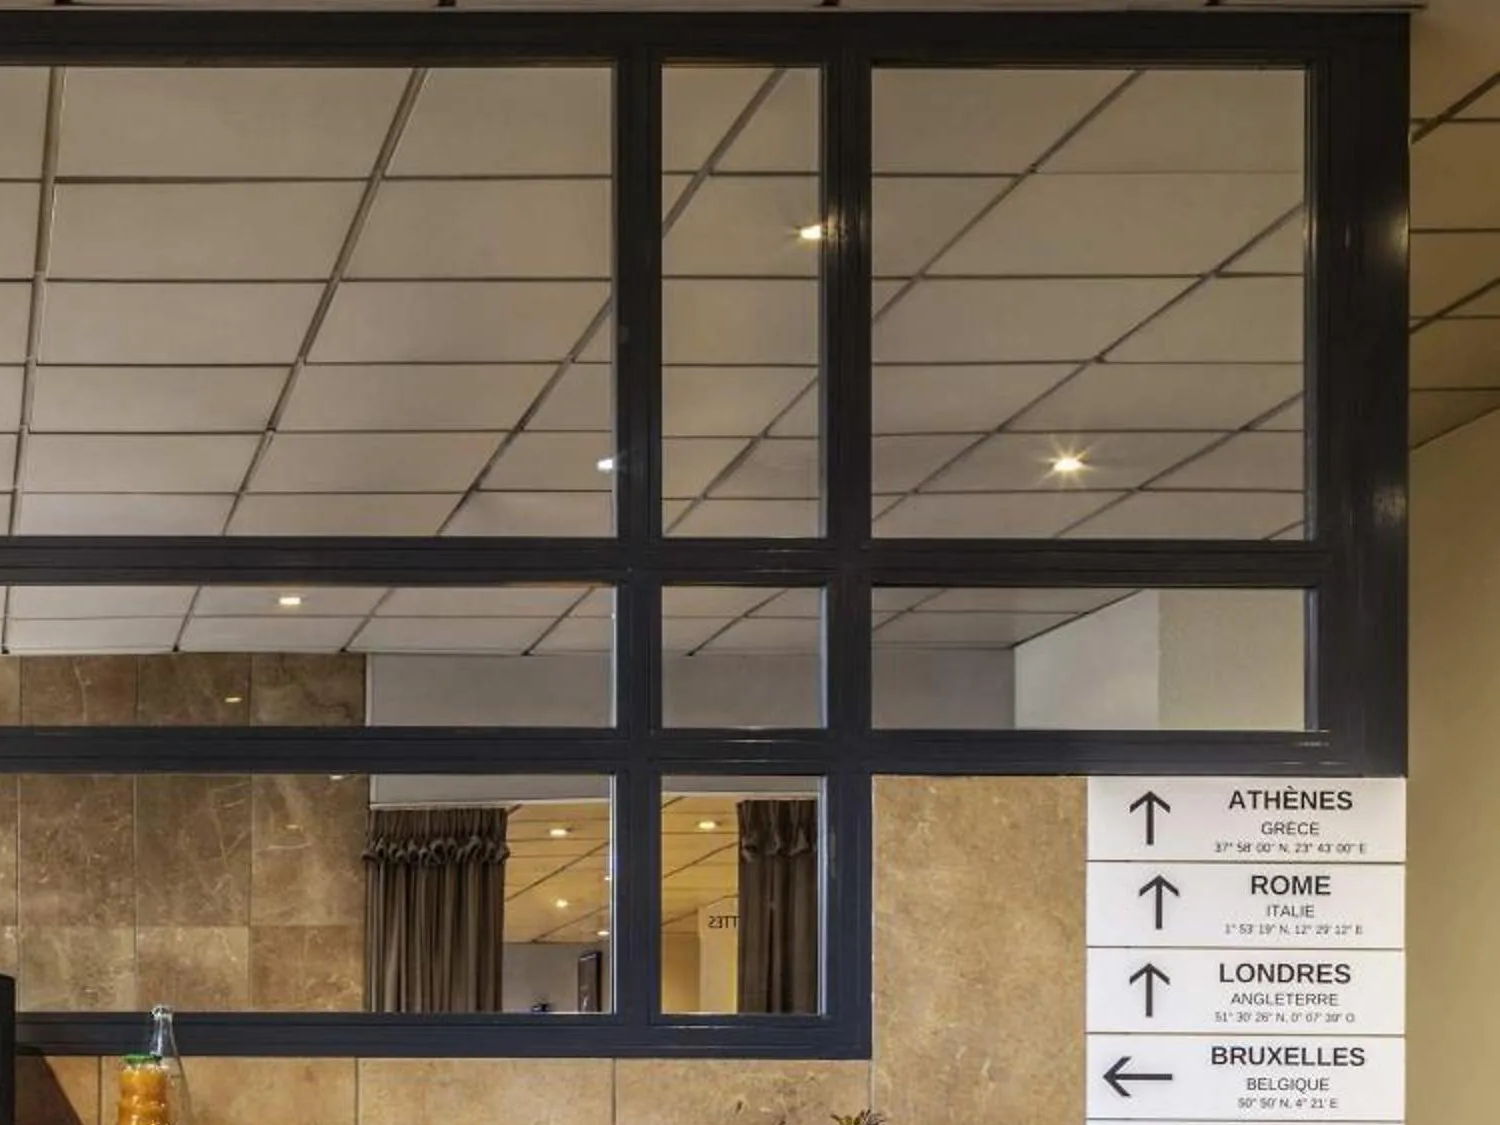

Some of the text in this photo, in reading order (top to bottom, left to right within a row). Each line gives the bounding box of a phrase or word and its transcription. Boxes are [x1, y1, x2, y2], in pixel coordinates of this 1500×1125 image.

[1228, 785, 1354, 811] ATHÈNES
[1359, 842, 1367, 854] E
[1251, 875, 1332, 896] ROME
[1266, 904, 1315, 919] ITALIE
[1355, 923, 1363, 935] E
[1220, 963, 1352, 985] LONDRES
[1230, 992, 1339, 1007] ANGLETERRE
[1211, 1046, 1366, 1067] BRUXELLES
[1246, 1077, 1331, 1094] BELGIQUE
[1329, 1097, 1339, 1109] E
